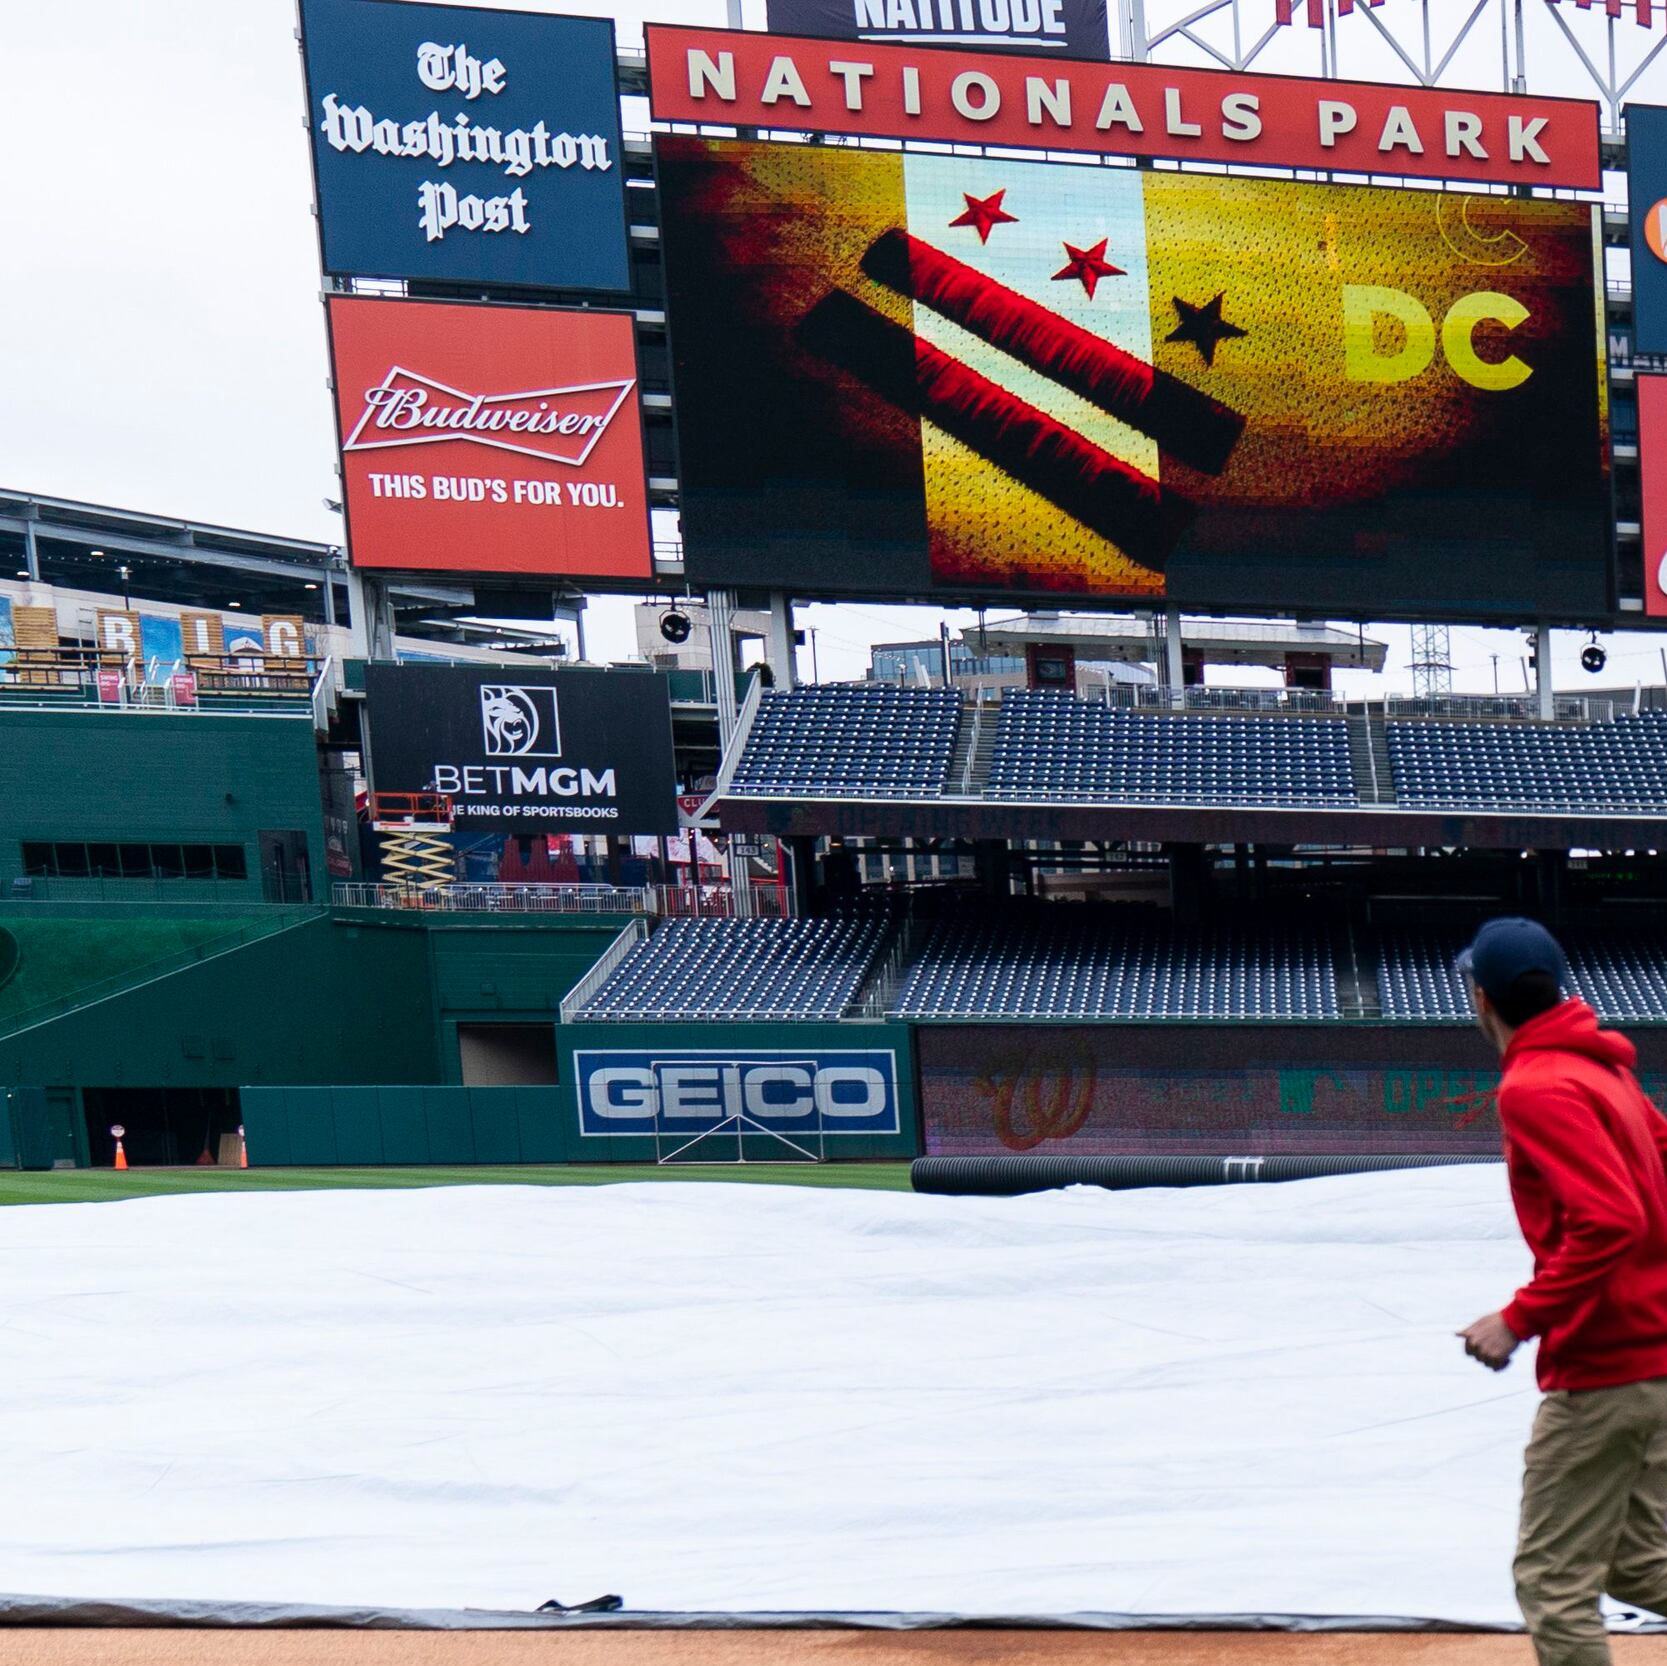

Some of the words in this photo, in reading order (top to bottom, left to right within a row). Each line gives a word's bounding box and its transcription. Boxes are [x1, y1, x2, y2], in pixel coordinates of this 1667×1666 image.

[416, 41, 507, 99] The
[687, 49, 1263, 141] NATIONALS
[1319, 99, 1551, 164] PARK
[321, 93, 613, 178] Washington
[417, 180, 530, 242] Post
[1342, 290, 1535, 391] DC
[364, 382, 607, 437] Budweiser
[369, 473, 427, 499] THIS
[432, 476, 508, 503] BUD'S
[515, 480, 562, 505] FOR
[566, 481, 625, 507] YOU.
[434, 765, 617, 797] BETMGM
[467, 805, 500, 816] KING
[502, 805, 521, 817] OF
[522, 806, 619, 819] SPORTSBOOKS
[590, 1067, 888, 1118] GEICO
